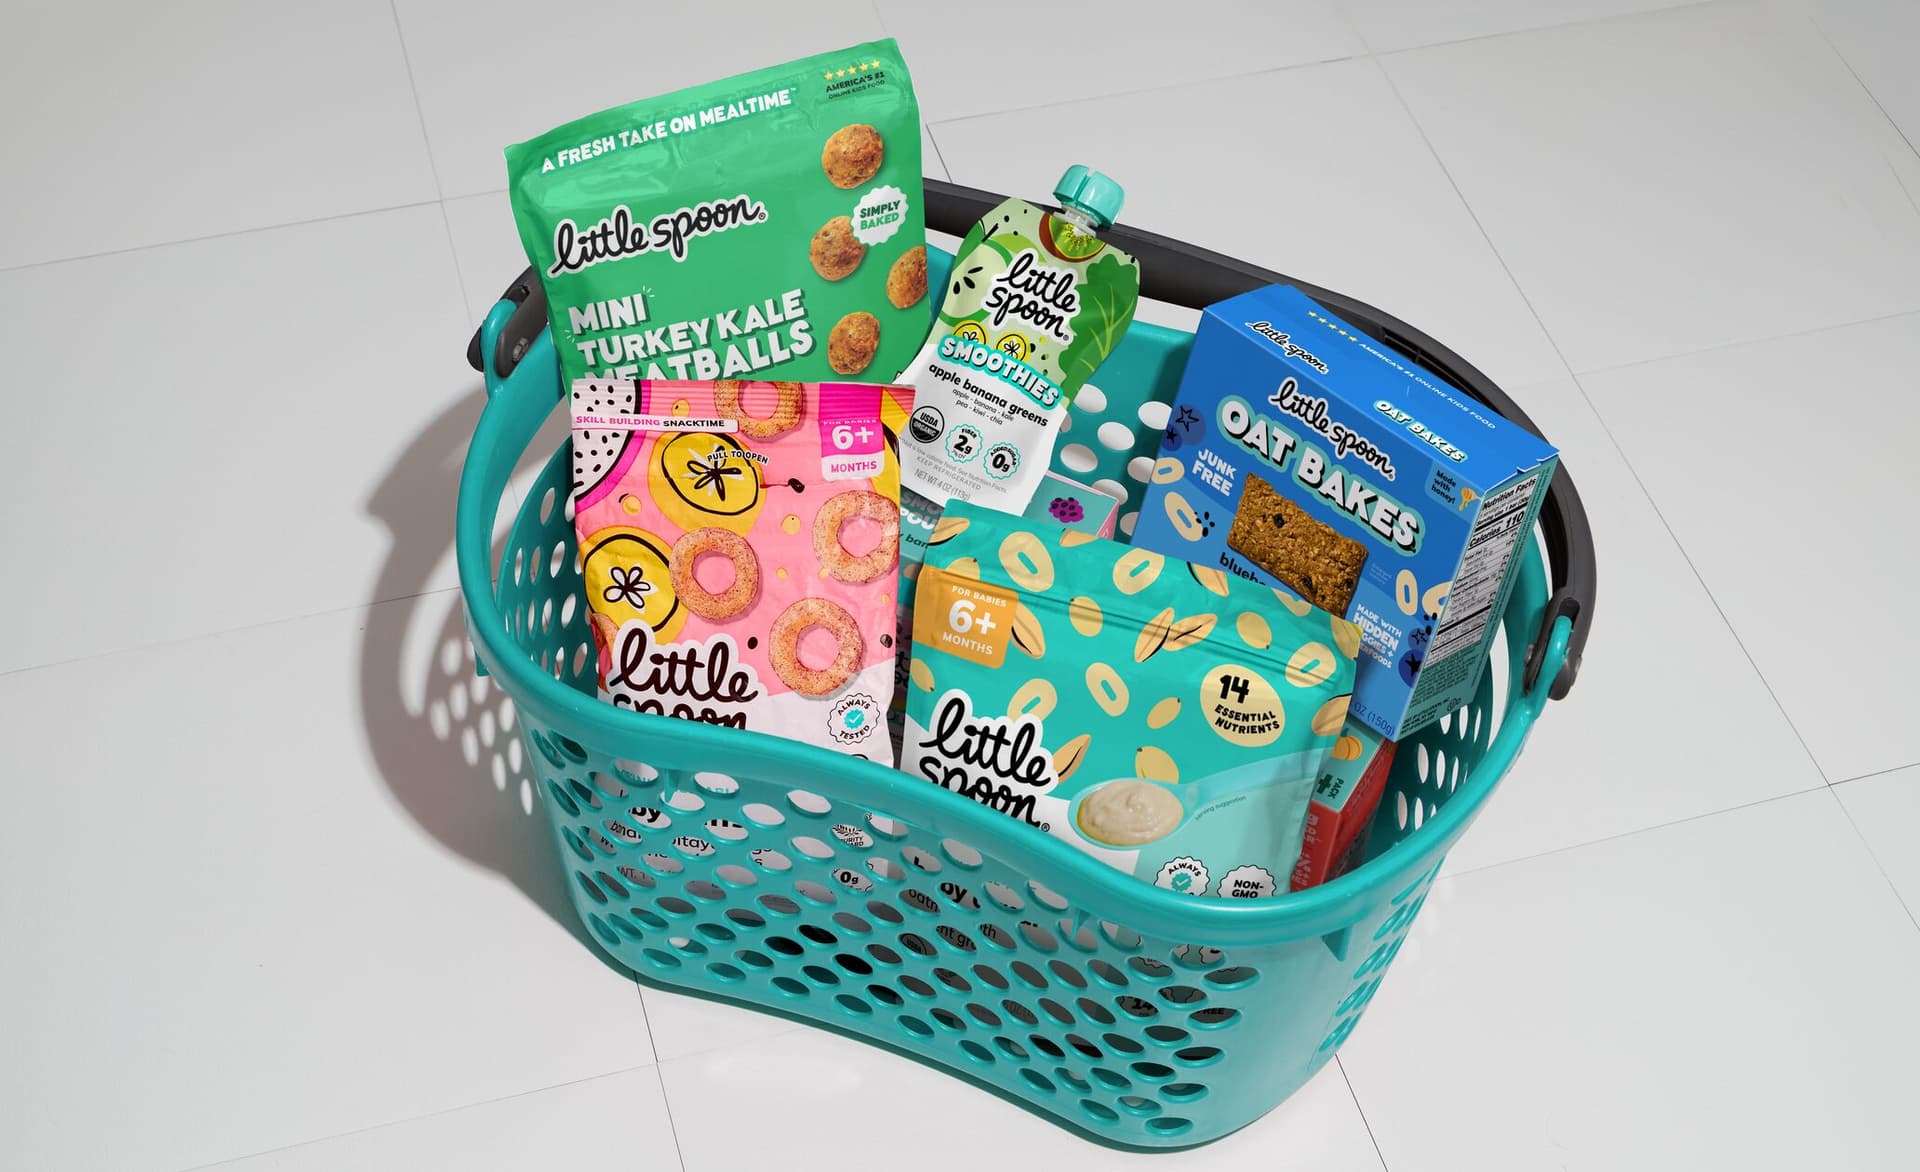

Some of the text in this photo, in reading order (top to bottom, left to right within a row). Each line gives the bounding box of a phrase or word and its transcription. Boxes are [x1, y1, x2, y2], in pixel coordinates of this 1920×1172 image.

[825, 71, 885, 93] AMERICA'S #1
[828, 89, 851, 99] ONLINE
[867, 79, 885, 89] FOOD
[541, 89, 792, 174] A FRESH TAKE ON MEALTIME
[859, 200, 901, 221] SIMPLY
[860, 213, 900, 231] BAKED
[551, 209, 649, 274] little
[996, 252, 1077, 313] little
[568, 293, 647, 335] MINI
[577, 288, 806, 367] TURKEY KALE
[1250, 322, 1287, 346] little
[584, 319, 814, 380] EATBALLS
[941, 337, 1059, 406] SMOOTHIES
[929, 364, 1049, 427] apple banana greens
[1359, 343, 1404, 371] AMERICA'S
[1415, 377, 1448, 398] ONLINE
[1447, 397, 1469, 412] KIDS
[1469, 411, 1496, 429] FOOD
[952, 388, 1014, 421] apple banana kale
[956, 398, 1003, 425] pea kiwi chia
[1271, 379, 1329, 434] little
[575, 415, 725, 428] SKILL BUILDING SNACKTIME
[913, 421, 937, 437] ORGANIC
[919, 412, 938, 427] USDA
[1376, 400, 1466, 462] OAT BAKES
[832, 425, 875, 450] 6+
[953, 435, 973, 454] 2g
[961, 428, 977, 439] FIBER
[707, 450, 769, 465] PULL TO OPEN
[831, 461, 877, 473] MONTHS
[992, 453, 1010, 473] 0g
[1198, 448, 1238, 480] JUNK
[914, 468, 928, 480] NET
[917, 456, 981, 490] KEEP REFRIGERATED
[1191, 460, 1235, 497] FREE
[1221, 400, 1418, 553] OAT BAKES
[1434, 478, 1450, 492] with
[1436, 469, 1456, 487] Made
[1431, 484, 1456, 504] honey!
[1483, 478, 1537, 510] Nutrition Facts
[1470, 526, 1501, 547] Calories
[1506, 510, 1525, 528] 110
[1219, 551, 1266, 585] blueb
[952, 585, 1007, 608] FOR BABIES
[949, 599, 997, 635] 6+
[1357, 603, 1402, 638] MADE WITH
[943, 632, 993, 655] MONTHS
[1353, 612, 1399, 651] HIDDEN
[1361, 633, 1386, 654] GGIES
[609, 628, 759, 702] little
[1219, 674, 1250, 704] 14
[837, 699, 871, 716] ALWAYS
[1214, 704, 1276, 722] ESSENTIAL
[1354, 702, 1367, 715] OZ
[1367, 711, 1395, 737] (150g)
[839, 725, 870, 740] TESTED
[1215, 717, 1280, 734] NUTRIENTS
[918, 697, 1051, 787] little
[1327, 777, 1345, 800] PACK
[840, 871, 859, 885] 0g
[1168, 862, 1202, 877] ALWAYS
[1231, 889, 1258, 899] GMO
[1233, 879, 1264, 890] NON-
